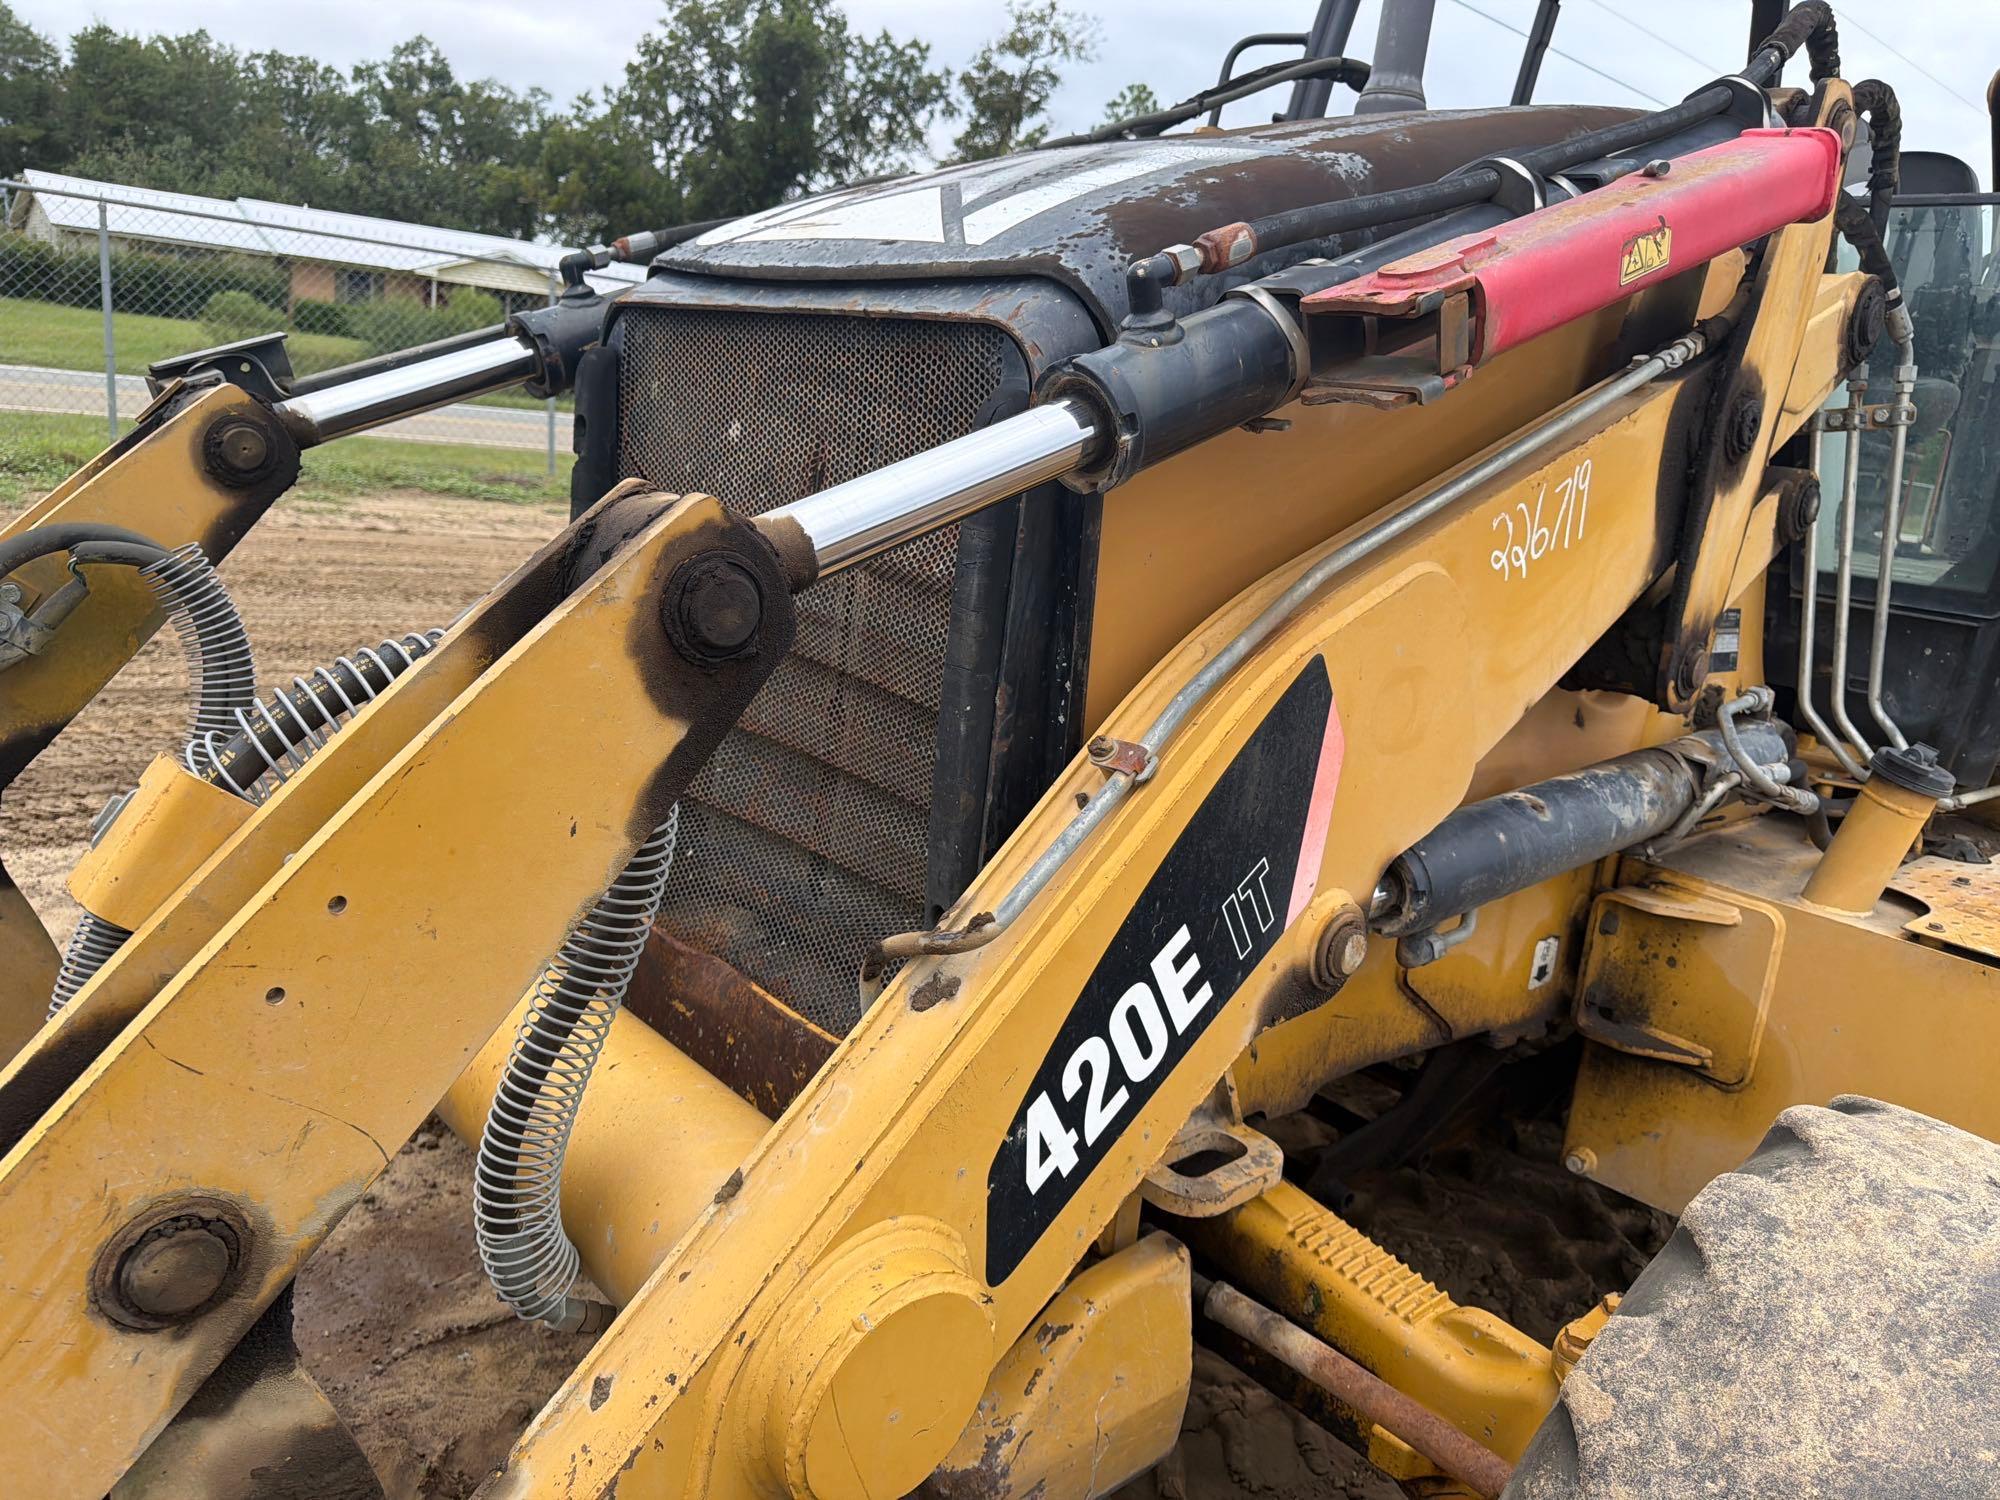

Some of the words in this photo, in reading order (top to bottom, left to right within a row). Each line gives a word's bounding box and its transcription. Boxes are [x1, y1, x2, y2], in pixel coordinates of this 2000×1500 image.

[1490, 459, 1592, 581] 226719
[1025, 923, 1214, 1196] 420E
[1221, 856, 1275, 961] IT
